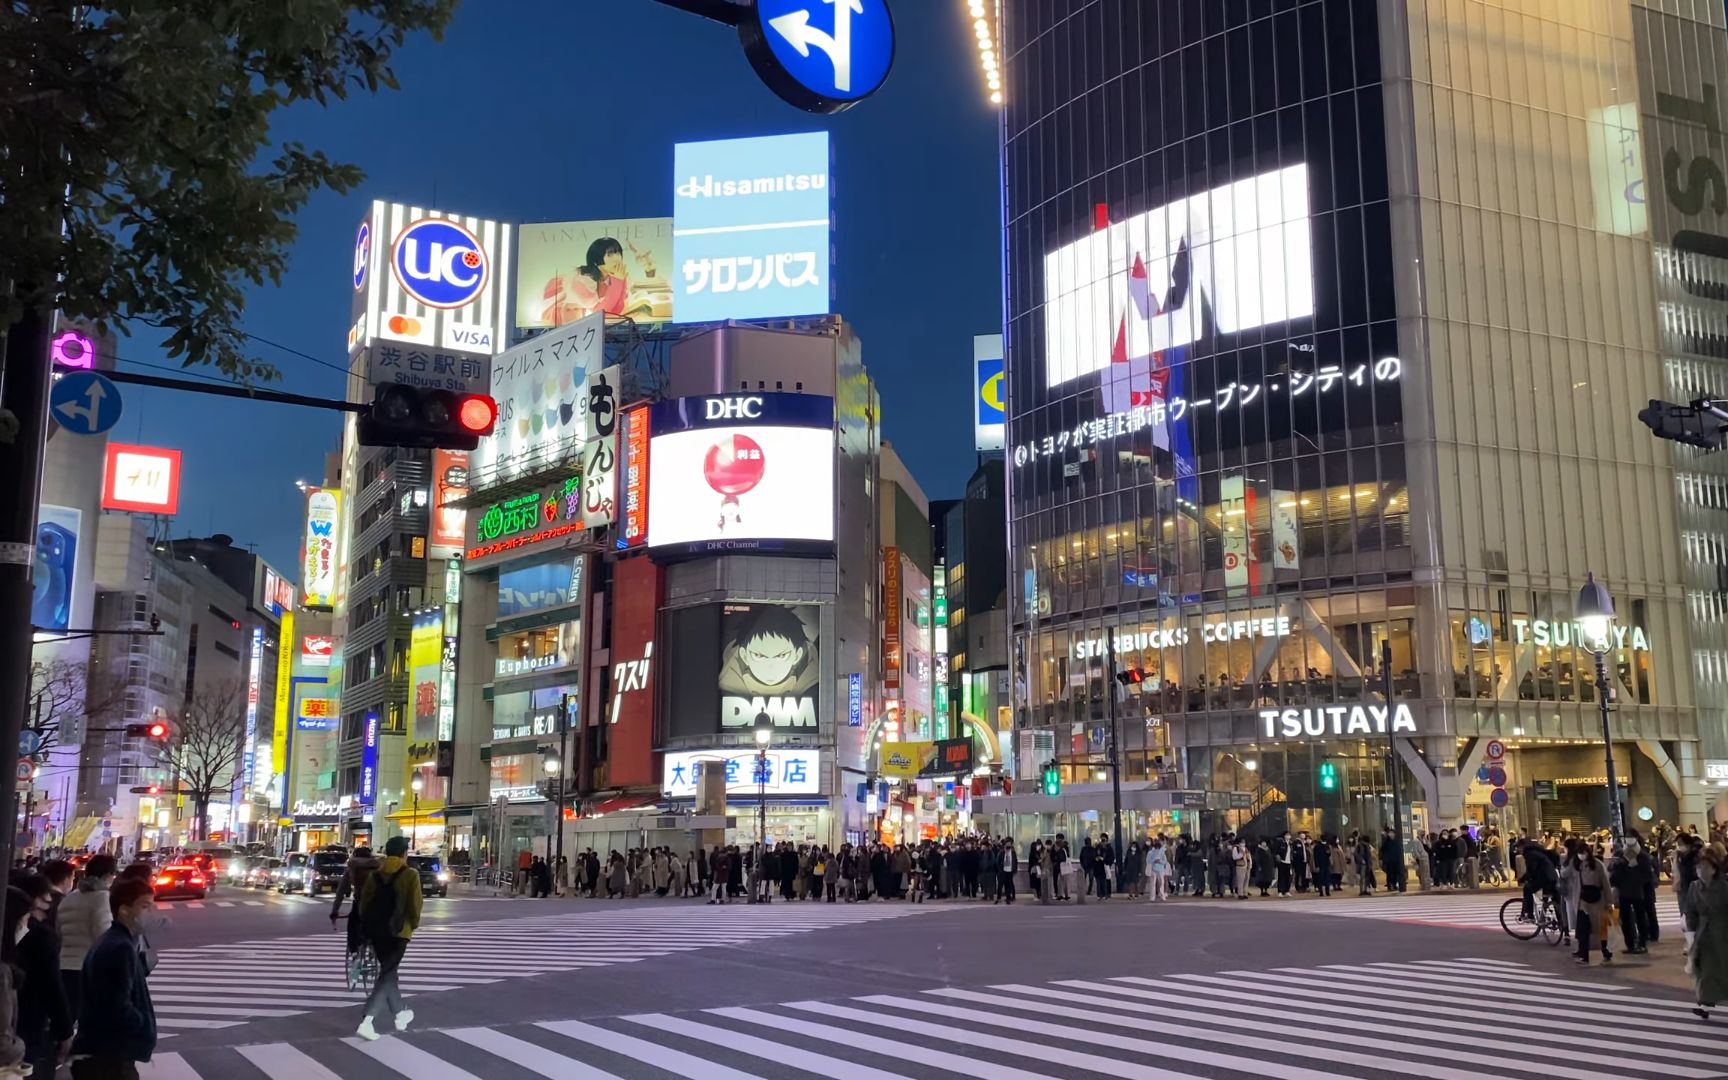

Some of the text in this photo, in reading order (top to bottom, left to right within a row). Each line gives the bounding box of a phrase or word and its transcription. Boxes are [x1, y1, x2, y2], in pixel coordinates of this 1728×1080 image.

[676, 173, 826, 199] Hisamitsu
[600, 223, 643, 240] THE
[355, 235, 369, 276] UC
[404, 237, 479, 288] UC
[682, 251, 819, 294] サロンパス
[452, 329, 490, 346] VISA
[551, 326, 597, 361] マスク
[379, 345, 482, 380] 渋谷駅前
[394, 371, 441, 389] Shibuya
[705, 396, 763, 420] DHC
[585, 373, 616, 520] もんじゃ
[503, 504, 539, 536] 西村
[706, 540, 760, 549] DHC Channel
[1076, 615, 1290, 660] STARBUCKS COFFEE
[499, 654, 555, 675] Euphoria
[722, 696, 817, 727] DMM
[1259, 703, 1417, 738] TSUTAYA
[367, 718, 377, 748] MIZUHO
[1554, 776, 1598, 786] STARBUCKS
